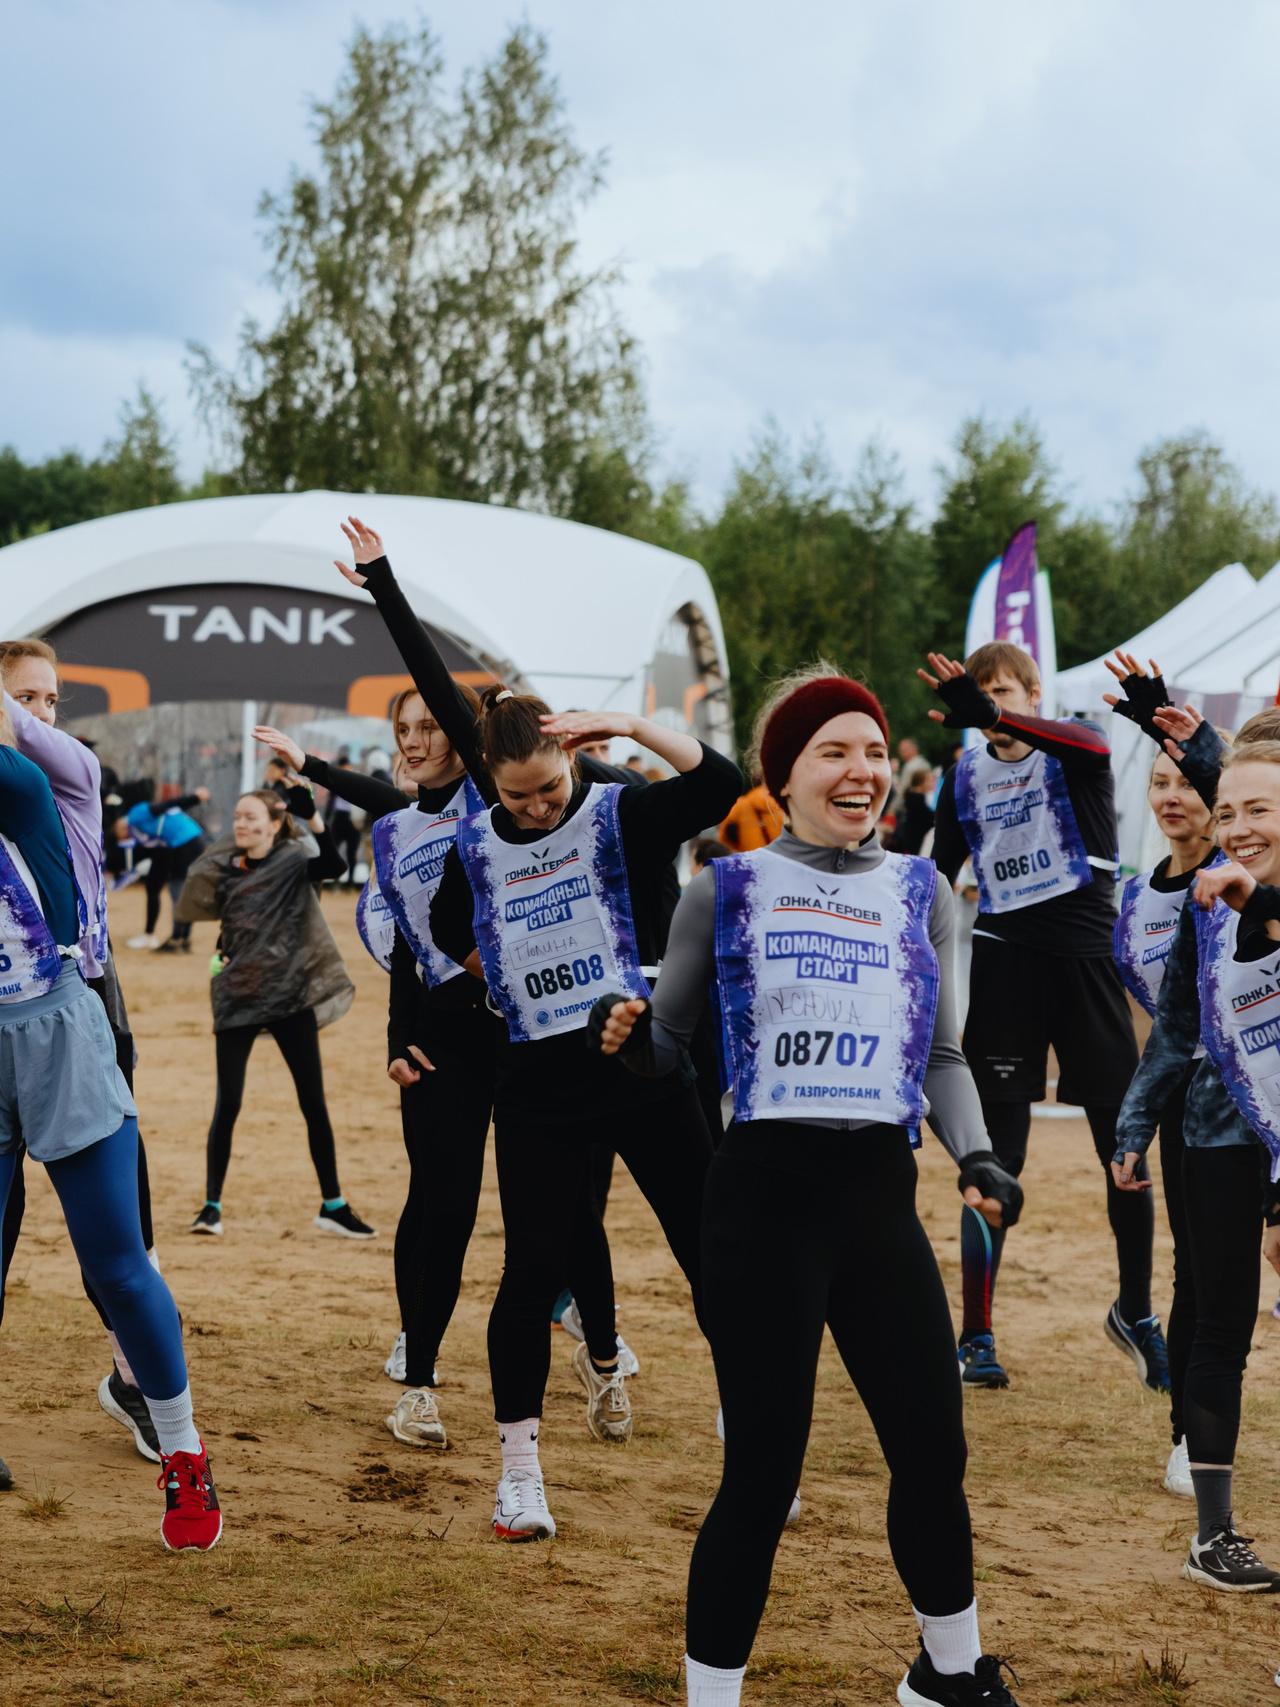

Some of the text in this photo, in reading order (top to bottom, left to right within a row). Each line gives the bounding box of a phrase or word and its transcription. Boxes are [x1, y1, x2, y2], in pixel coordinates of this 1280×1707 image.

[148, 605, 356, 645] TANK
[418, 857, 445, 881] СТАР
[505, 866, 539, 882] ГОНКА
[994, 849, 1051, 882] 08610
[506, 876, 589, 919] КОМАНДНЫЙ
[773, 896, 882, 922] ГОНКА ГЕРОЕВ
[529, 904, 568, 928] СТАРТ
[768, 935, 887, 965] КОМАНДНЫЙ
[524, 954, 604, 1000] 08608
[800, 957, 855, 982] СТАРТ
[1231, 983, 1274, 1009] ГОНКА
[774, 1030, 880, 1068] 08707
[794, 1086, 881, 1100] ГАЗПРОМБАНК
